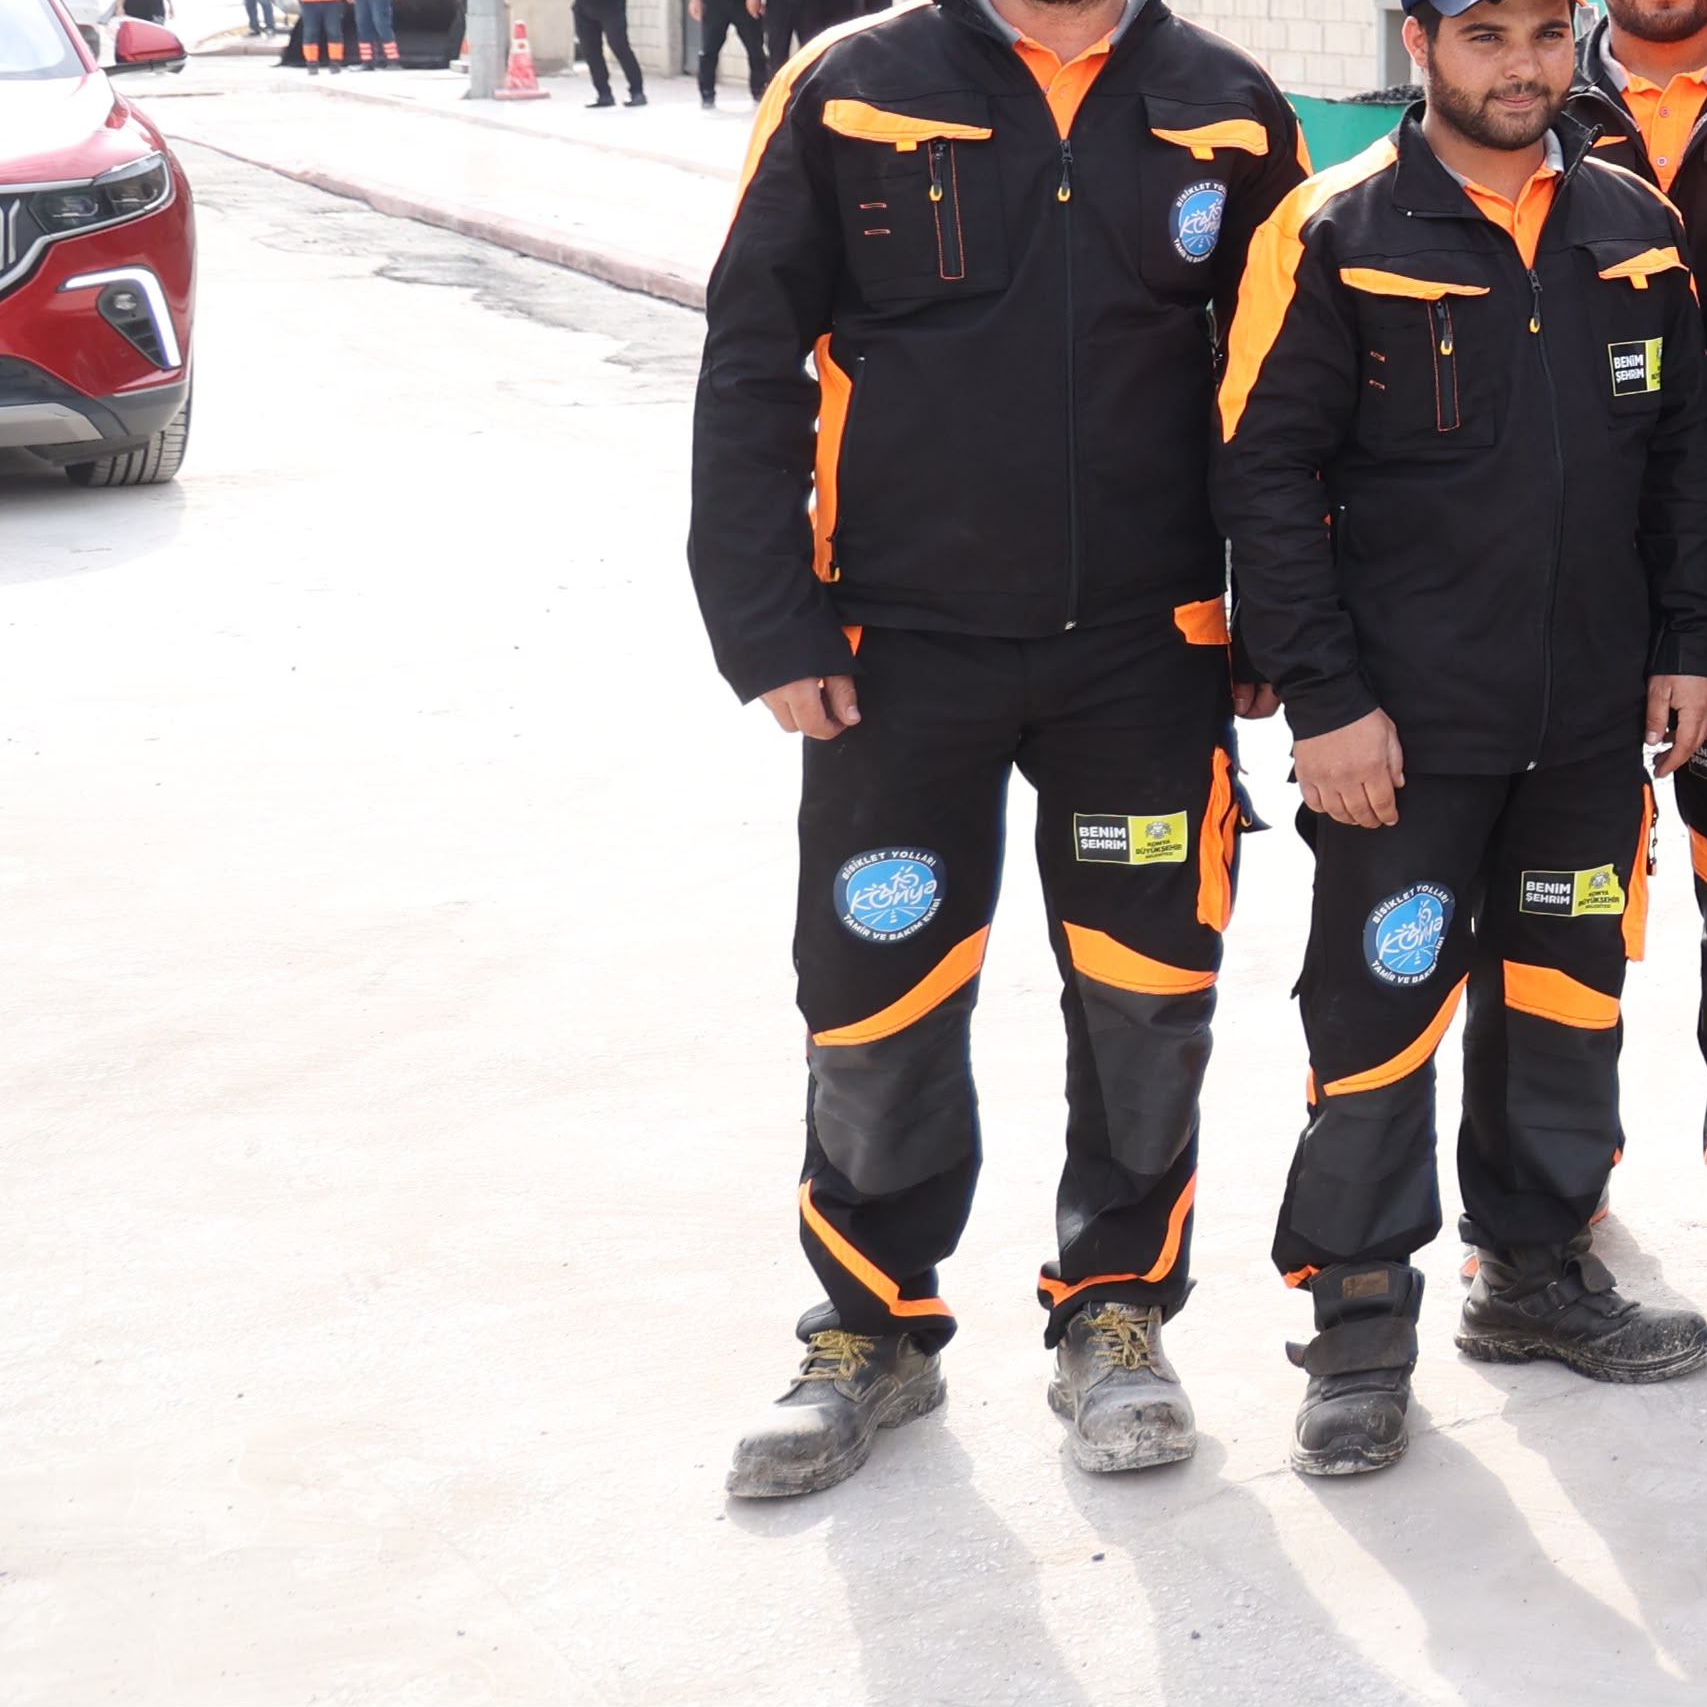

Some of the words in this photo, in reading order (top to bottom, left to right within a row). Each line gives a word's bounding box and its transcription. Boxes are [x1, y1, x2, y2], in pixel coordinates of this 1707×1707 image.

[1614, 354, 1644, 369] BENİM
[1615, 367, 1644, 384] ŞEHRİM
[1079, 827, 1126, 839] BENİM
[1080, 839, 1127, 851] ŞEHRİM
[842, 852, 886, 881] BİSİKLET
[891, 851, 936, 867] YOLLARI
[1526, 881, 1571, 895] BENİM
[1372, 889, 1415, 924] BİSİKLET
[1416, 884, 1449, 904] YOLLARI
[1525, 893, 1569, 905] ŞEHRİM
[843, 914, 870, 937] TAMİR
[873, 932, 889, 941] VE
[889, 922, 922, 941] BAKIM
[923, 898, 942, 923] EKİBİ
[1371, 961, 1396, 983] TAMİR
[1397, 975, 1410, 984] VE
[1412, 962, 1437, 984] BAKIM
